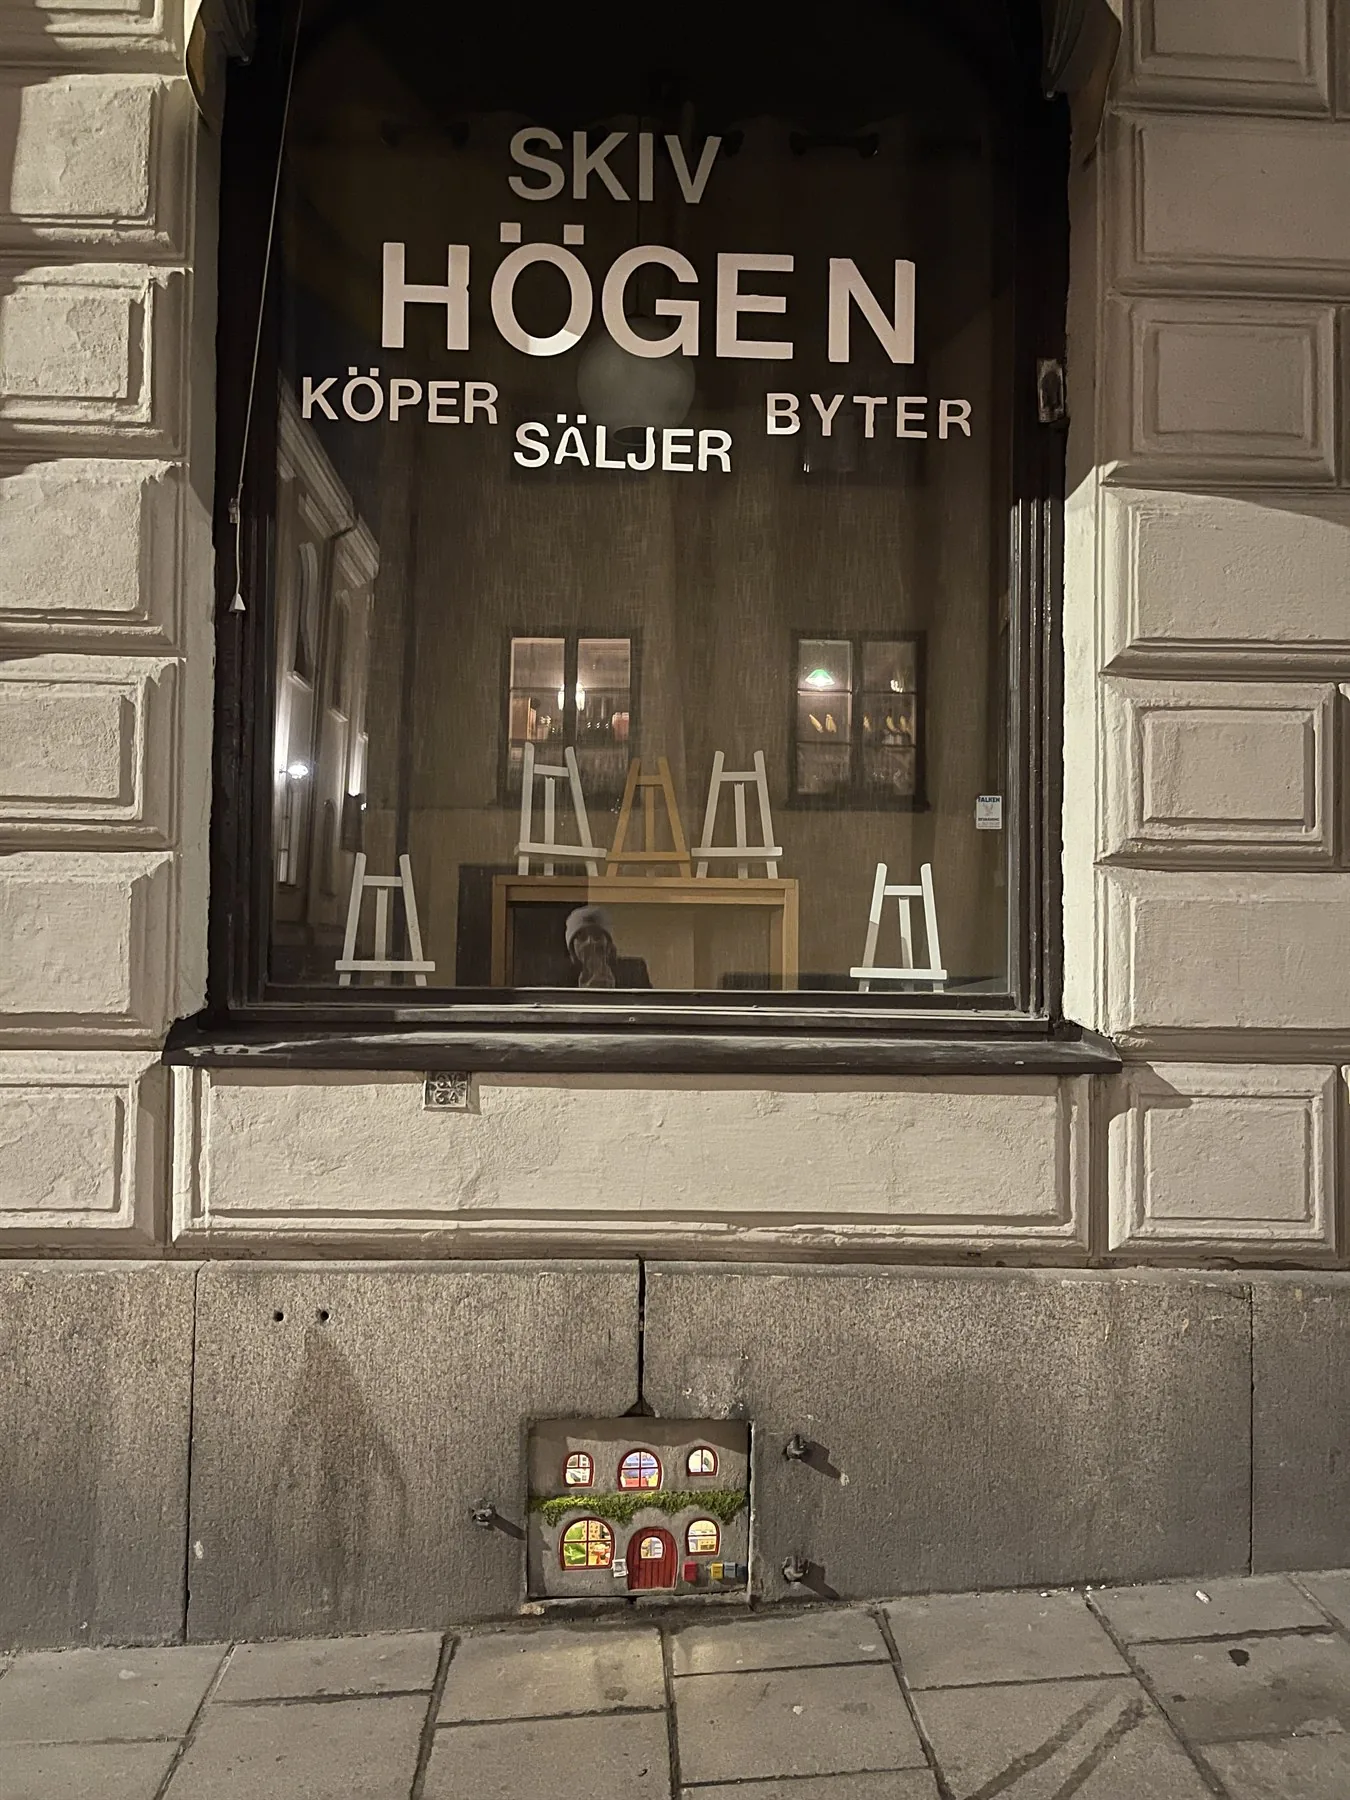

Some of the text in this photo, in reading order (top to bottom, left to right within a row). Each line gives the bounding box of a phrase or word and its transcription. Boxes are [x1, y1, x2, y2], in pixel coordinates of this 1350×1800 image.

[508, 127, 722, 204] SKIV
[381, 222, 916, 364] HÖGEN
[301, 366, 499, 425] KÖPER
[766, 392, 972, 440] BYTER
[513, 413, 733, 473] SÄLJER
